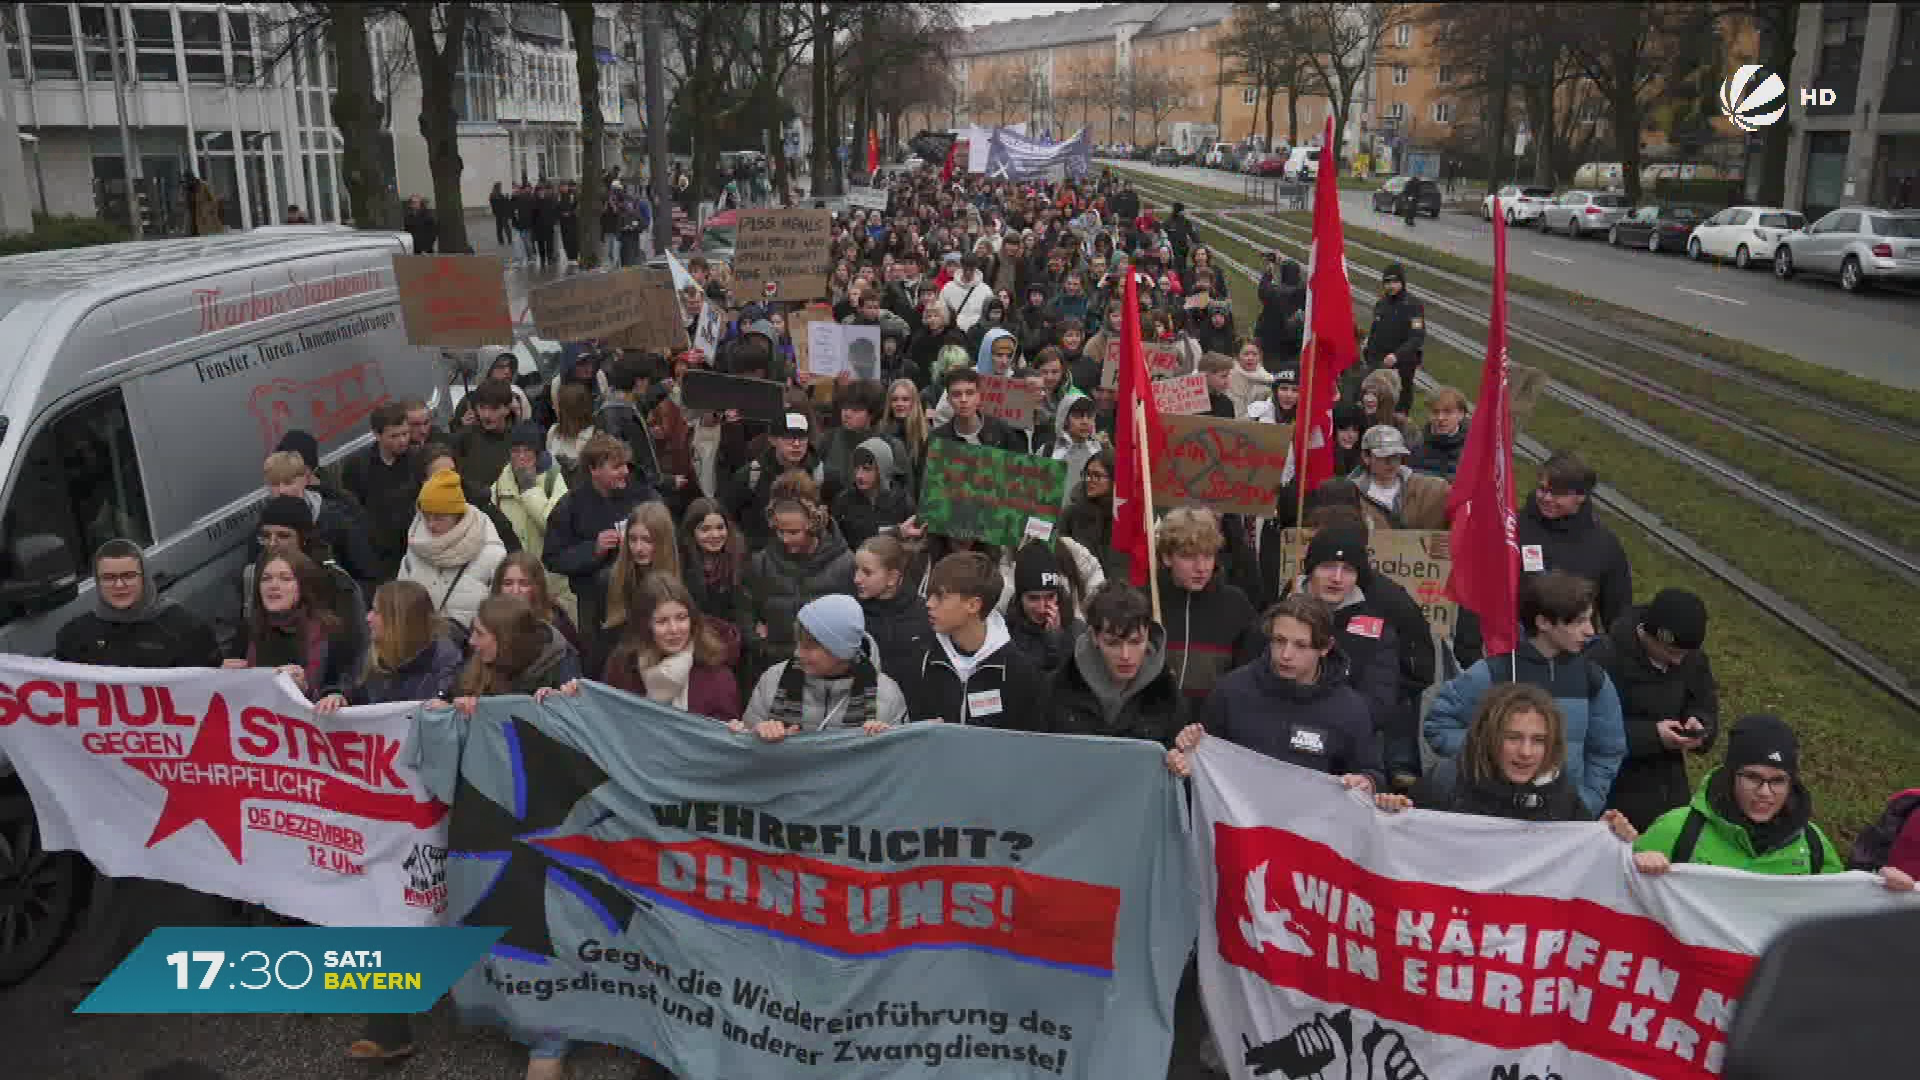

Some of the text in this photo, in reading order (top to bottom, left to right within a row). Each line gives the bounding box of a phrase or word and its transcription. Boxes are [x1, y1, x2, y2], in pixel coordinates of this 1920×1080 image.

[192, 278, 285, 334] Markus
[82, 731, 184, 756] GEGEN
[238, 706, 408, 789] STREIK
[150, 762, 326, 801] WEHRPFLICHT
[248, 806, 365, 850] 05 DEZEMBER
[308, 845, 326, 868] 12
[652, 801, 1035, 864] WEHRPFLICHT?
[658, 849, 1015, 935] OHNE UNS!
[1291, 871, 1375, 938] WIR
[1395, 905, 1680, 1003] KÄMPFEN
[577, 938, 1073, 1042] Gegen die Wiedereinführung des
[1326, 932, 1380, 981] IN
[1403, 956, 1593, 1024] EUREN
[662, 997, 715, 1028] und
[722, 1018, 824, 1066] anderer
[834, 1034, 1069, 1075] Zwangdienste!
